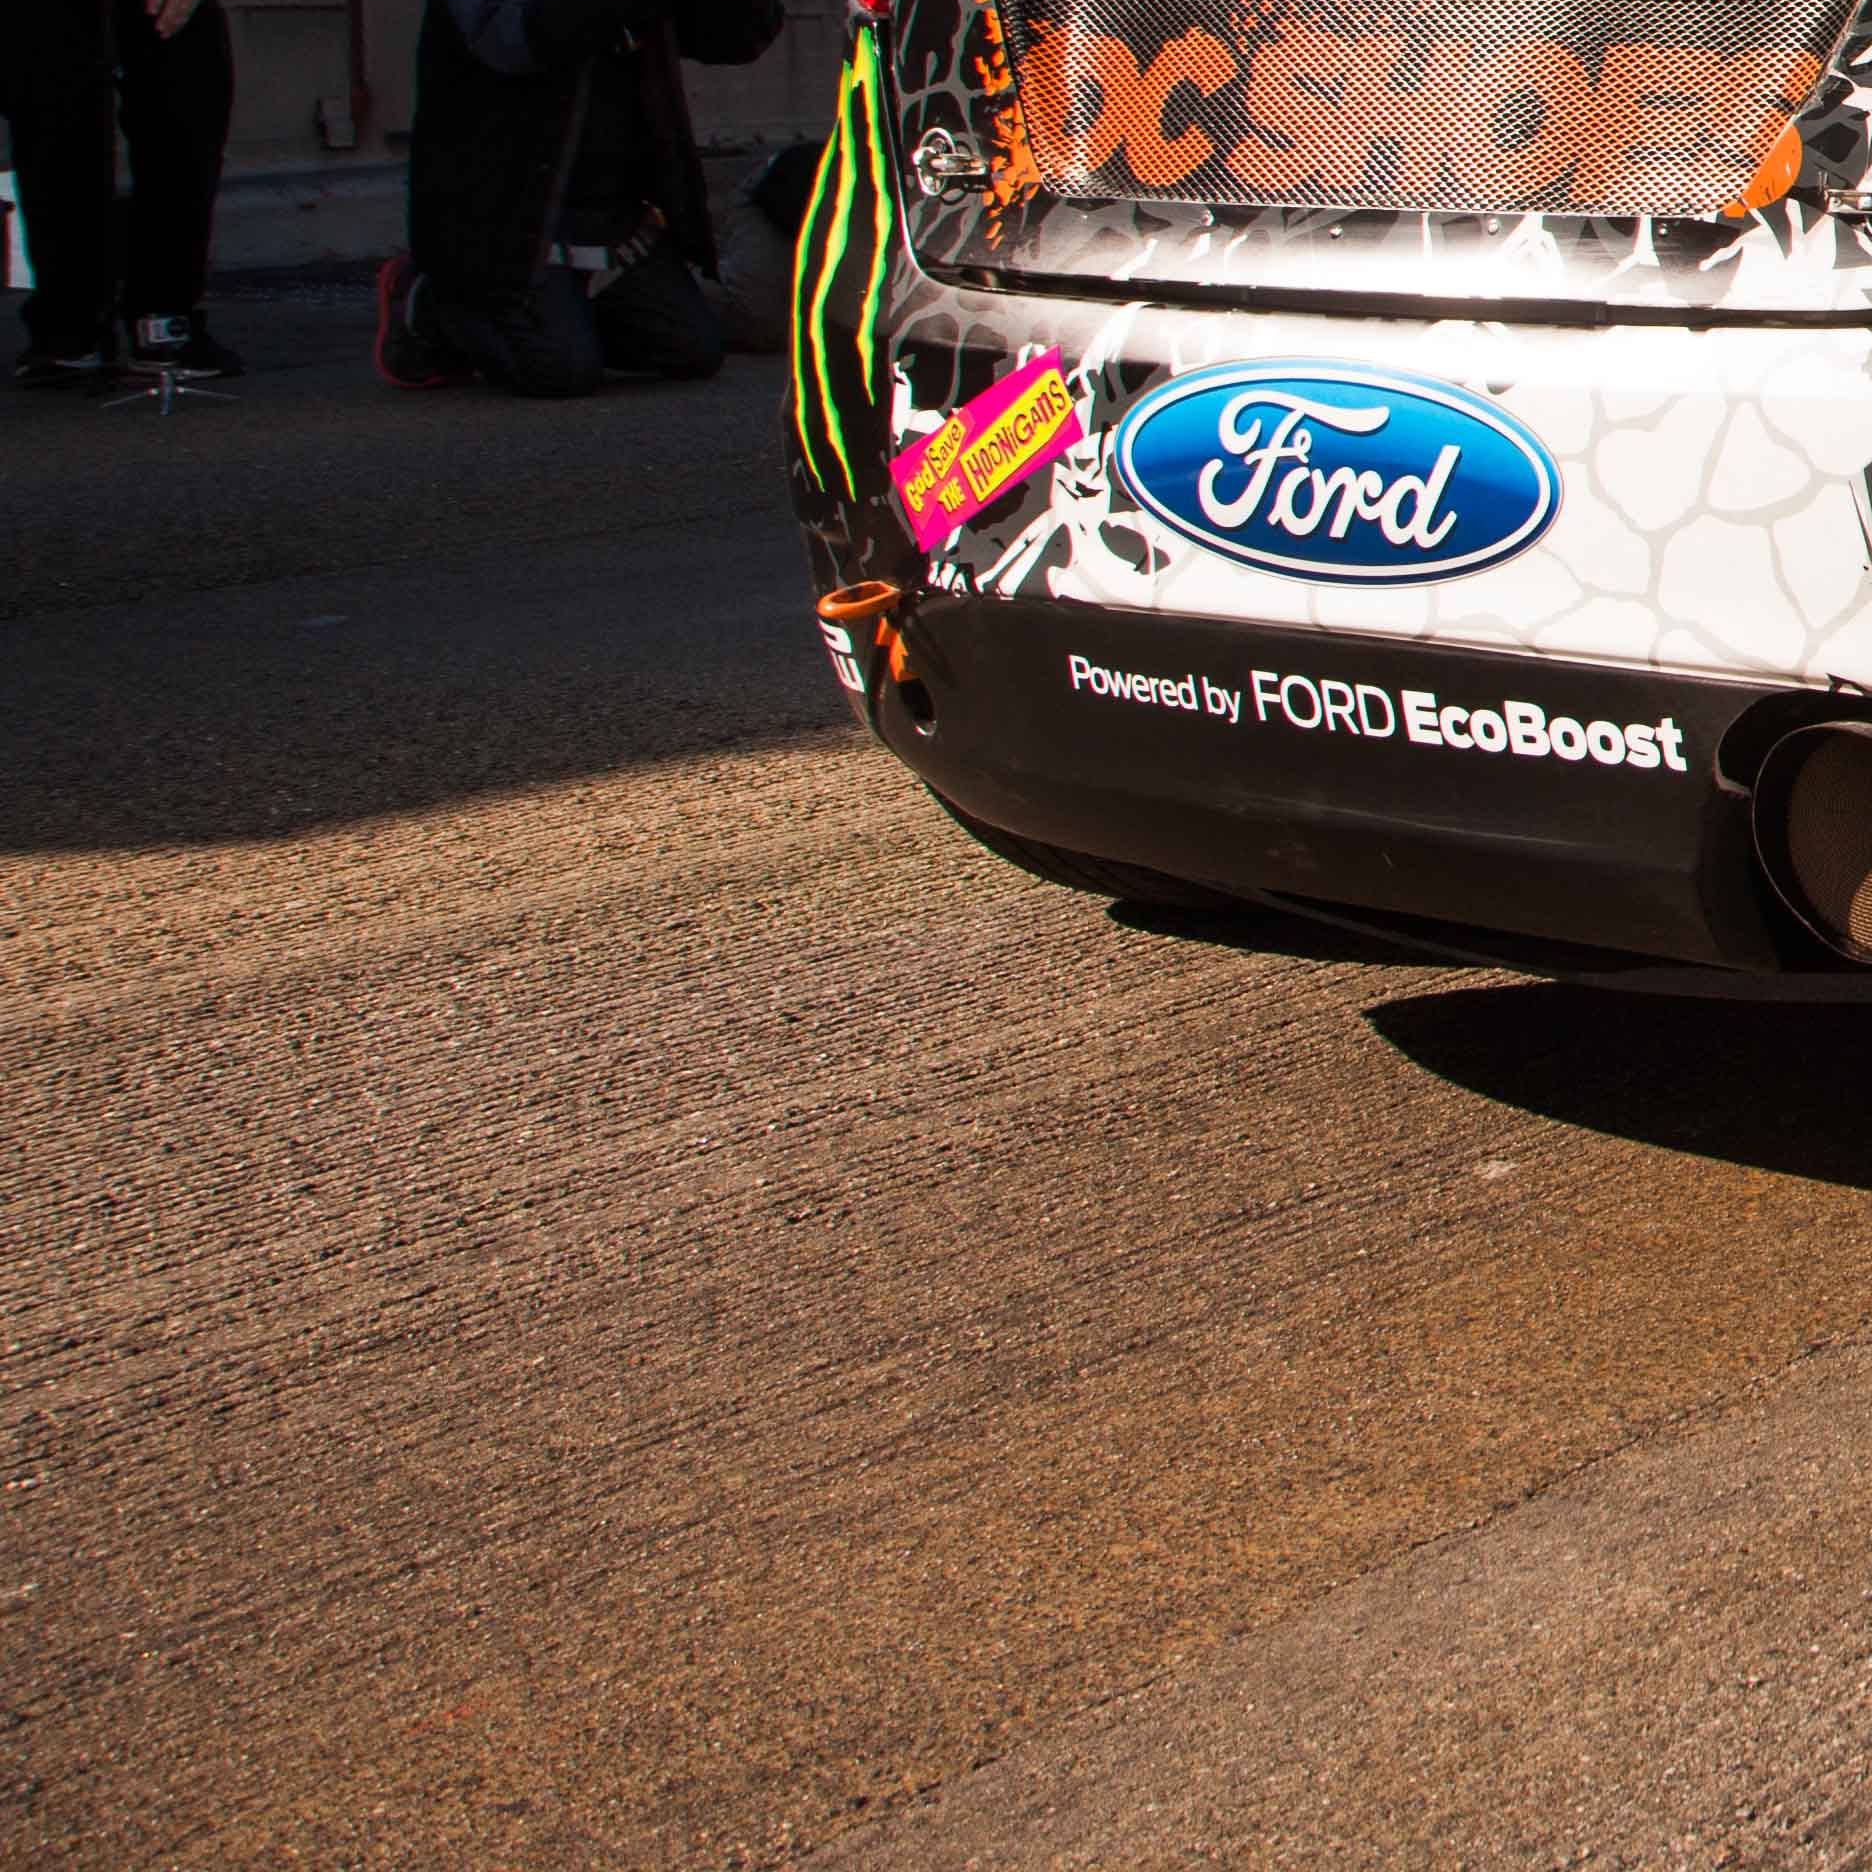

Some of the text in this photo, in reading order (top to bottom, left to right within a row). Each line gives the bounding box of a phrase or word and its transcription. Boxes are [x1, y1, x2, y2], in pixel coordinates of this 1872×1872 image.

[927, 421, 963, 472] Save
[1198, 388, 1466, 552] Ford
[1068, 653, 1688, 773] Powered by FORD EcoBoost
